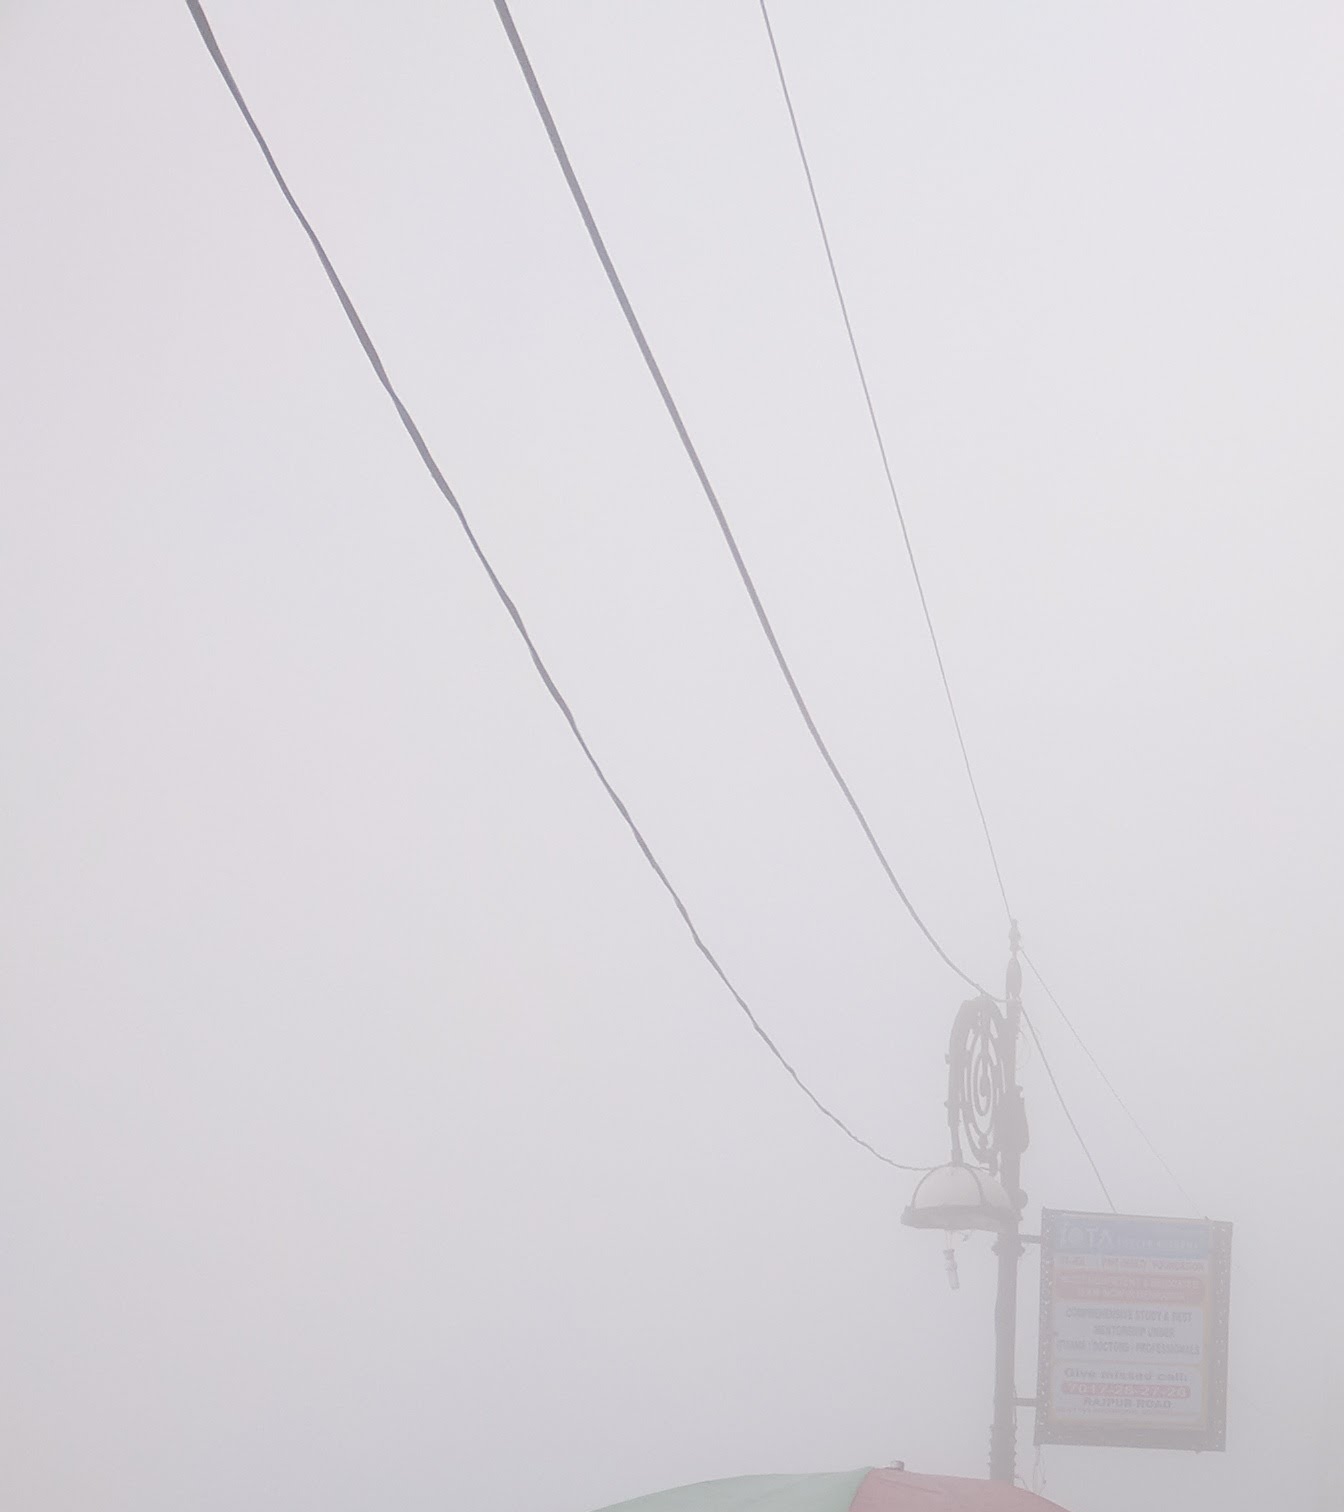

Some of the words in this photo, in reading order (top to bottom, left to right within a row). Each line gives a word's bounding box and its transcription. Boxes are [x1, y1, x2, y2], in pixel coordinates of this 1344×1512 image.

[1135, 1310, 1161, 1321] STUDY
[1064, 1367, 1096, 1378] Give
[1101, 1370, 1152, 1381] missed
[1083, 1397, 1132, 1408] RAJPUR
